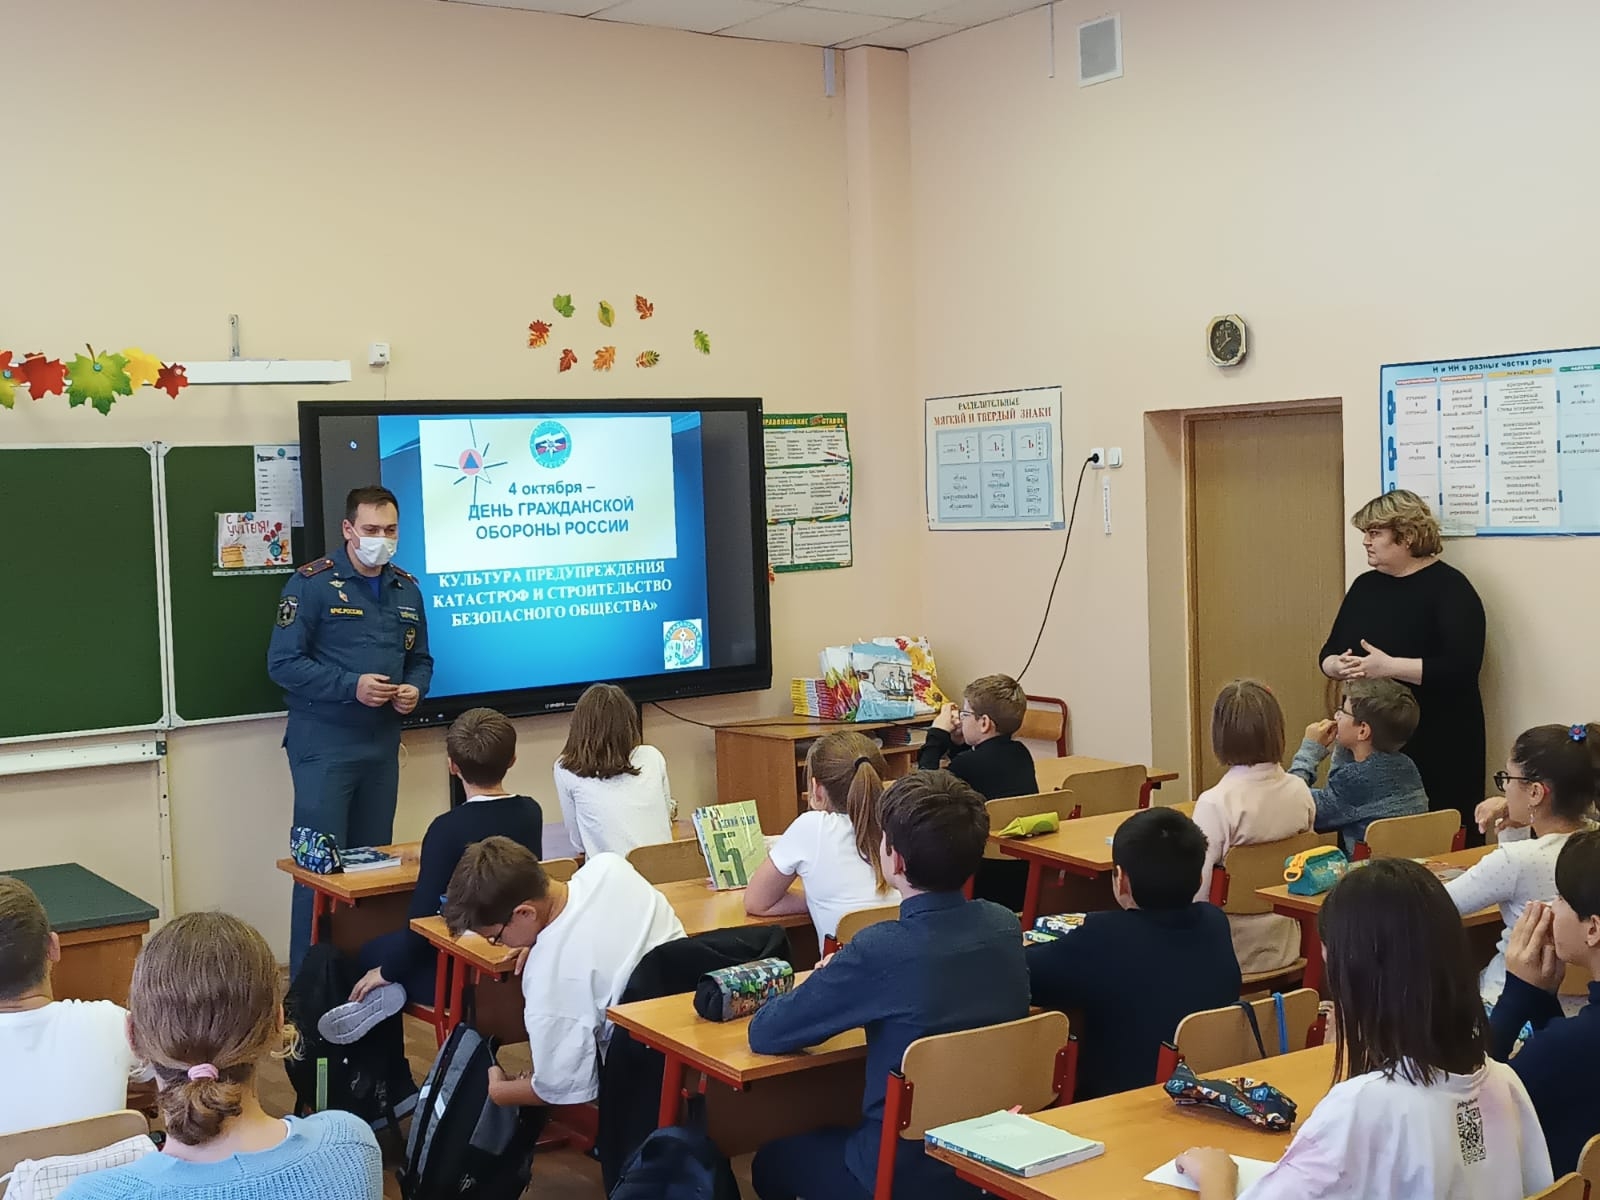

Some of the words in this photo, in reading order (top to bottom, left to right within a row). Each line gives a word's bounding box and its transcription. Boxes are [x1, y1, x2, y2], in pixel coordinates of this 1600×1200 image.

[1469, 363, 1499, 372] разных
[1501, 360, 1530, 368] частях
[1532, 358, 1553, 367] речи
[958, 397, 1020, 411] РАЗДЕЛИТЕЛЬНЫЕ
[934, 413, 966, 426] МЯГКИЙ
[968, 413, 975, 424] И
[977, 409, 1016, 423] ТВЕРДЫЙ
[1020, 407, 1052, 419] ЗНАКИ
[508, 482, 517, 495] 4
[522, 481, 582, 497] октября
[468, 503, 513, 520] ДЕНЬ
[518, 496, 634, 517] ГРАЖДАНСКОЙ
[476, 522, 560, 540] ОБОРОНЫ
[566, 519, 629, 535] РОССИИ
[439, 569, 522, 588] КУЛЬТУРА
[525, 561, 665, 582] ПРЕДУПРЕЖДЕНИЯ
[433, 589, 529, 608] КАТАСТРОФ
[533, 589, 544, 600] И
[547, 579, 672, 599] СТРОИТЕЛЬСТВО
[451, 605, 566, 627] БЕЗОПАСНОГО
[569, 600, 658, 618] ОБЩЕСТВА»
[713, 833, 748, 887] 5
